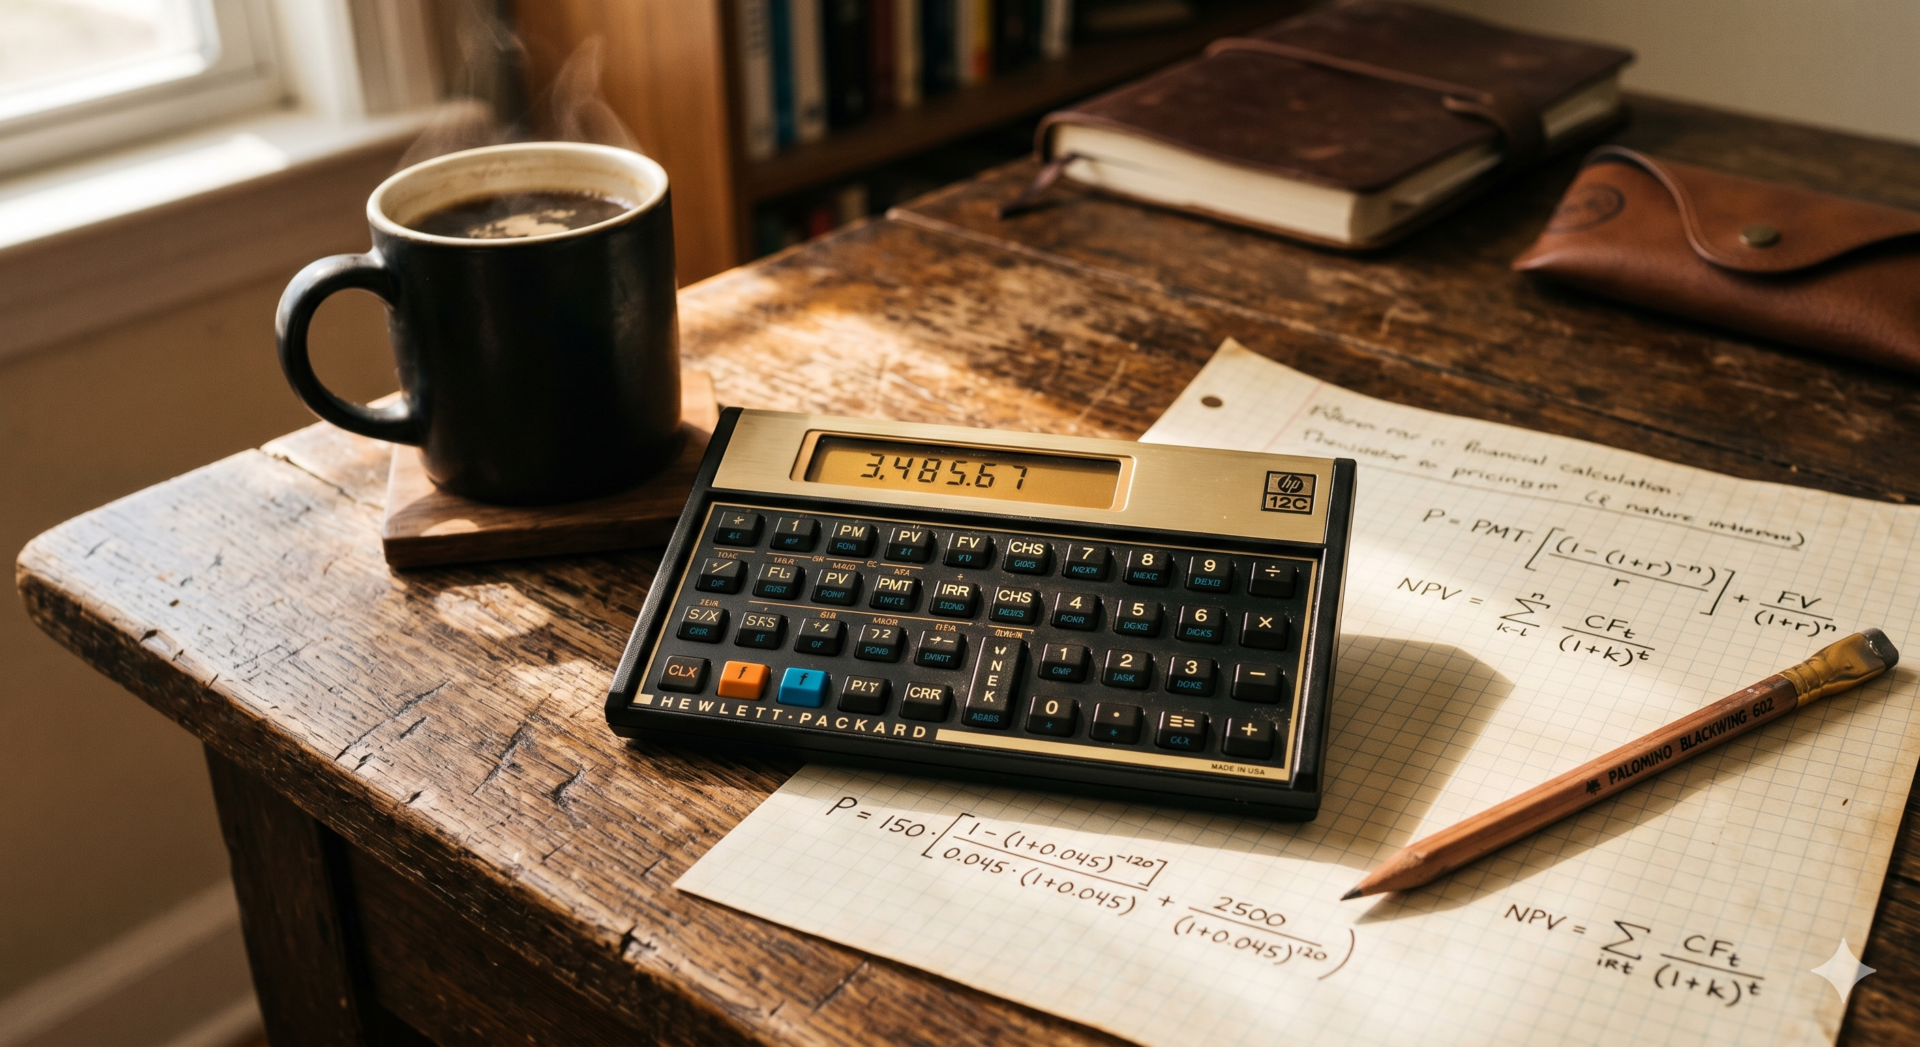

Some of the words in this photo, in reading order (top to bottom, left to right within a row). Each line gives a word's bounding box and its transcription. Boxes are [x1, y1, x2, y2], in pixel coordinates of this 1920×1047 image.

[1280, 475, 1301, 493] hp
[1269, 496, 1308, 511] 12C
[1422, 508, 1446, 523] P
[792, 519, 800, 532] 1
[839, 525, 866, 538] PM
[899, 531, 922, 543] PV
[957, 536, 980, 549] FV
[1010, 541, 1044, 555] CHS
[1083, 547, 1094, 560] 7
[1142, 553, 1154, 566] 8
[1203, 559, 1216, 572] 9
[825, 572, 849, 585] PV
[878, 577, 913, 592] PMT
[941, 584, 970, 597] IRR
[1397, 577, 1462, 600] NPV
[998, 589, 1033, 604] CHS
[1070, 596, 1082, 610] 4
[1777, 590, 1823, 610] FV
[1132, 603, 1145, 616] 5
[1195, 608, 1208, 622] 6
[1060, 647, 1070, 661] 1
[1119, 654, 1133, 668] 2
[668, 664, 698, 679] CLX
[737, 666, 748, 680] f
[1184, 660, 1198, 675] 3
[798, 672, 809, 686] f
[909, 686, 943, 701] CRR
[1608, 745, 1673, 785] PALOMINO
[1679, 709, 1748, 753] BLACKWING
[1752, 697, 1775, 718] 602
[1211, 763, 1235, 772] MADE
[826, 796, 857, 816] P
[879, 815, 926, 837] 150
[1213, 896, 1287, 927] 2500
[1504, 903, 1568, 930] NPV
